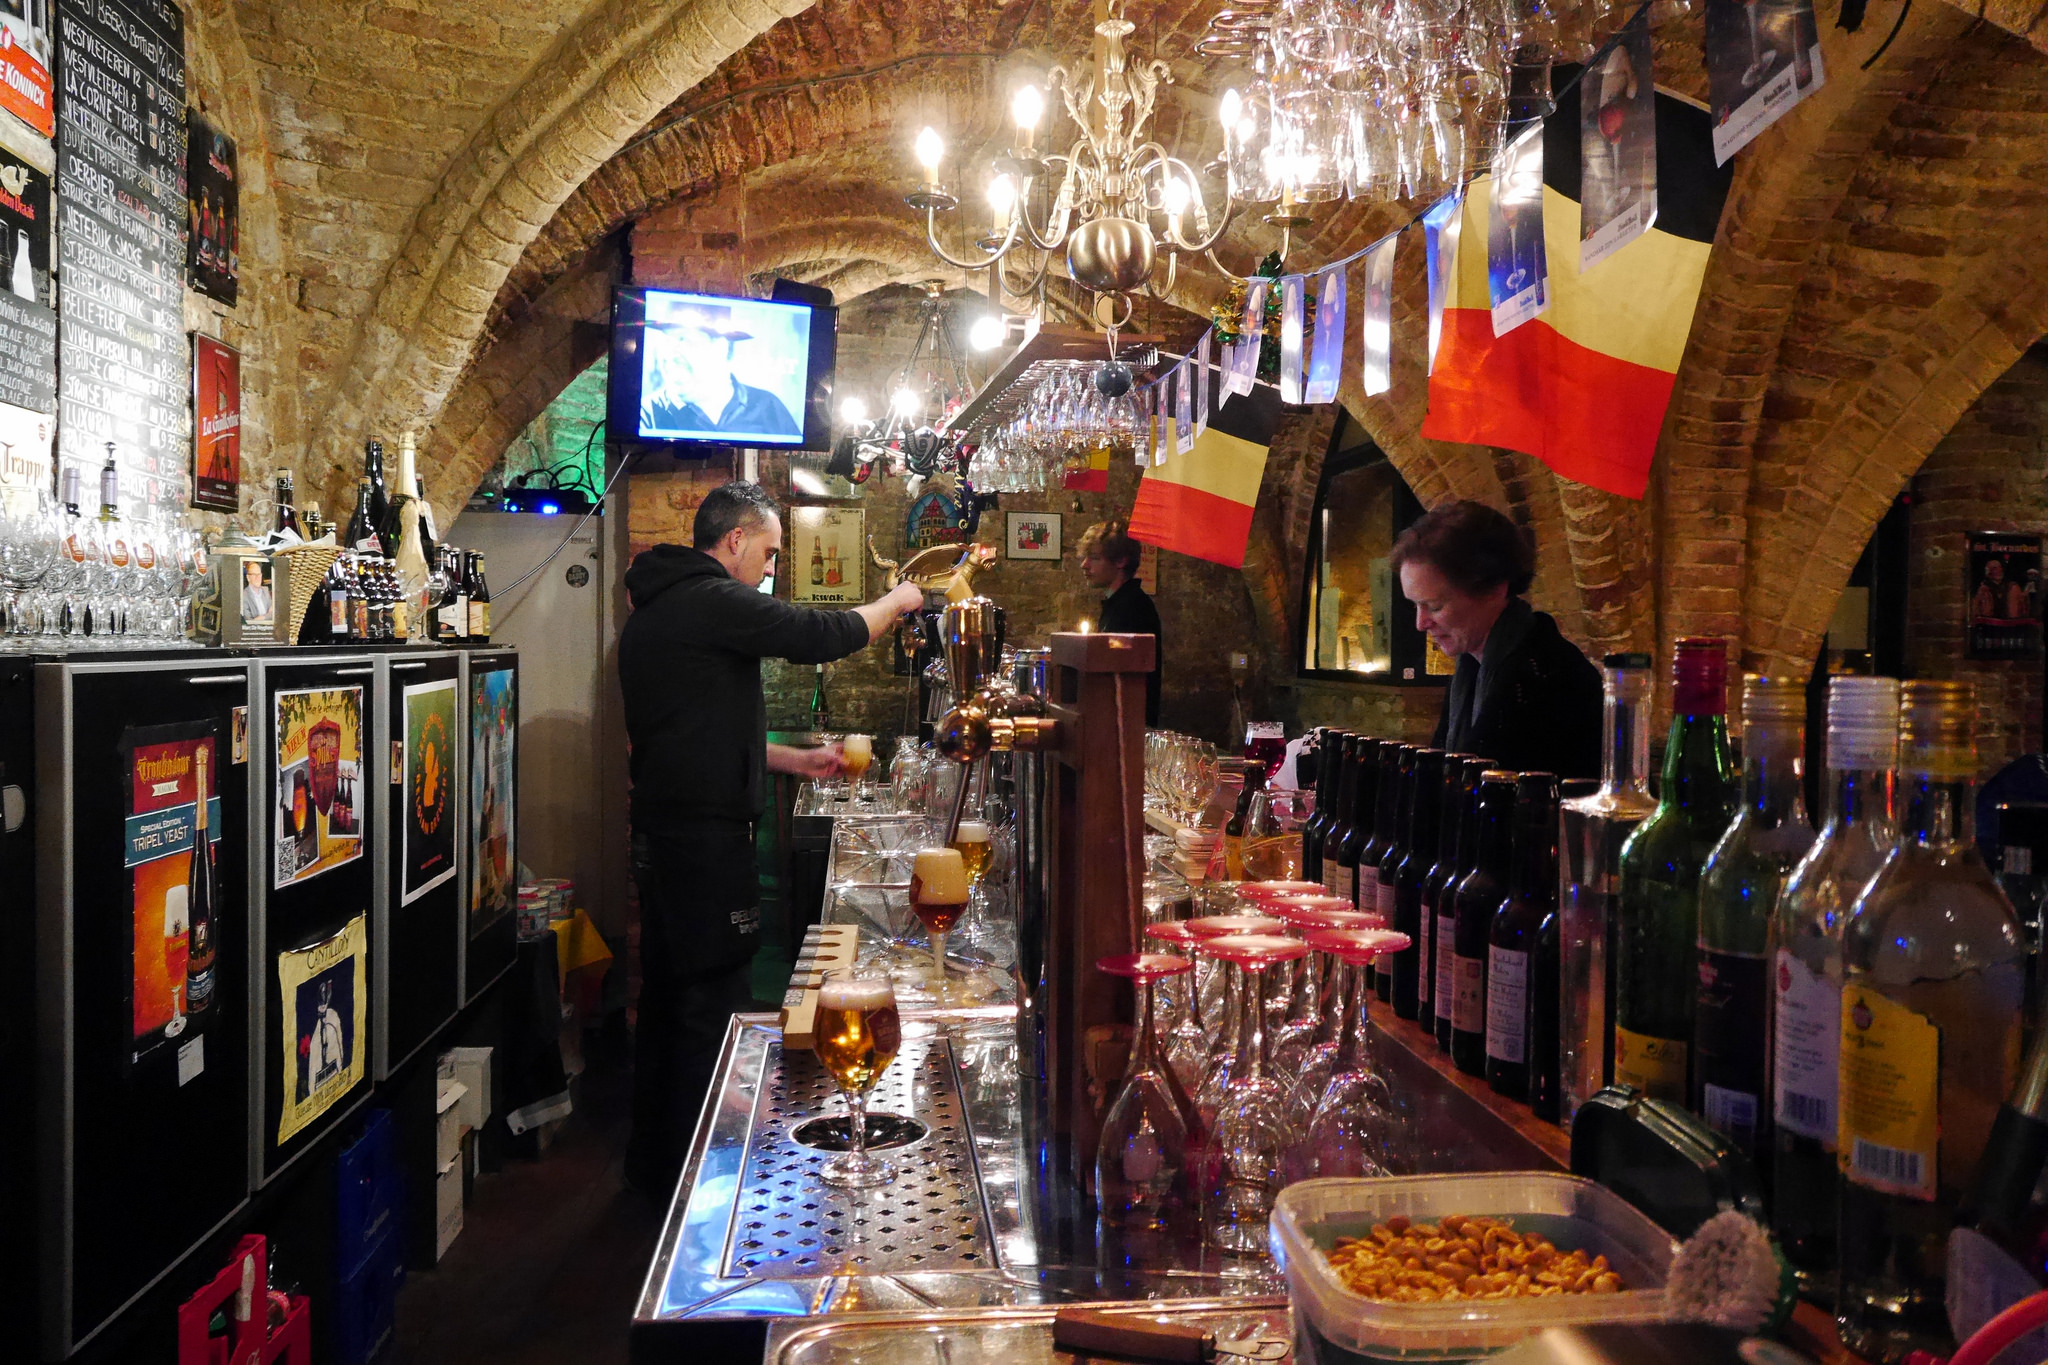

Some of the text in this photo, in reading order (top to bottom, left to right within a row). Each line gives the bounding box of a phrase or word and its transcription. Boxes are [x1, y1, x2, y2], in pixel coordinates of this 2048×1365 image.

[62, 16, 131, 79] WESTVLETEREN
[132, 67, 141, 89] 12
[5, 61, 46, 110] KONINCK
[62, 40, 129, 108] WESTVLETEREN
[131, 93, 138, 112] 8
[65, 67, 78, 97] LA
[80, 81, 113, 124] CORNE
[114, 104, 145, 146] TRIPEL
[64, 124, 93, 162] DUVEL
[62, 261, 98, 297] TRIPEL
[63, 288, 95, 325] BELLE
[95, 304, 127, 338] FLEUR
[8, 328, 23, 344] ALE
[66, 321, 94, 355] VIVEN
[64, 346, 101, 380] STRUISE
[8, 391, 23, 405] ALE
[64, 374, 101, 408] STRUISE
[133, 825, 188, 853] TRIPEL YEAST
[140, 817, 182, 834] SPECIAL EDITION
